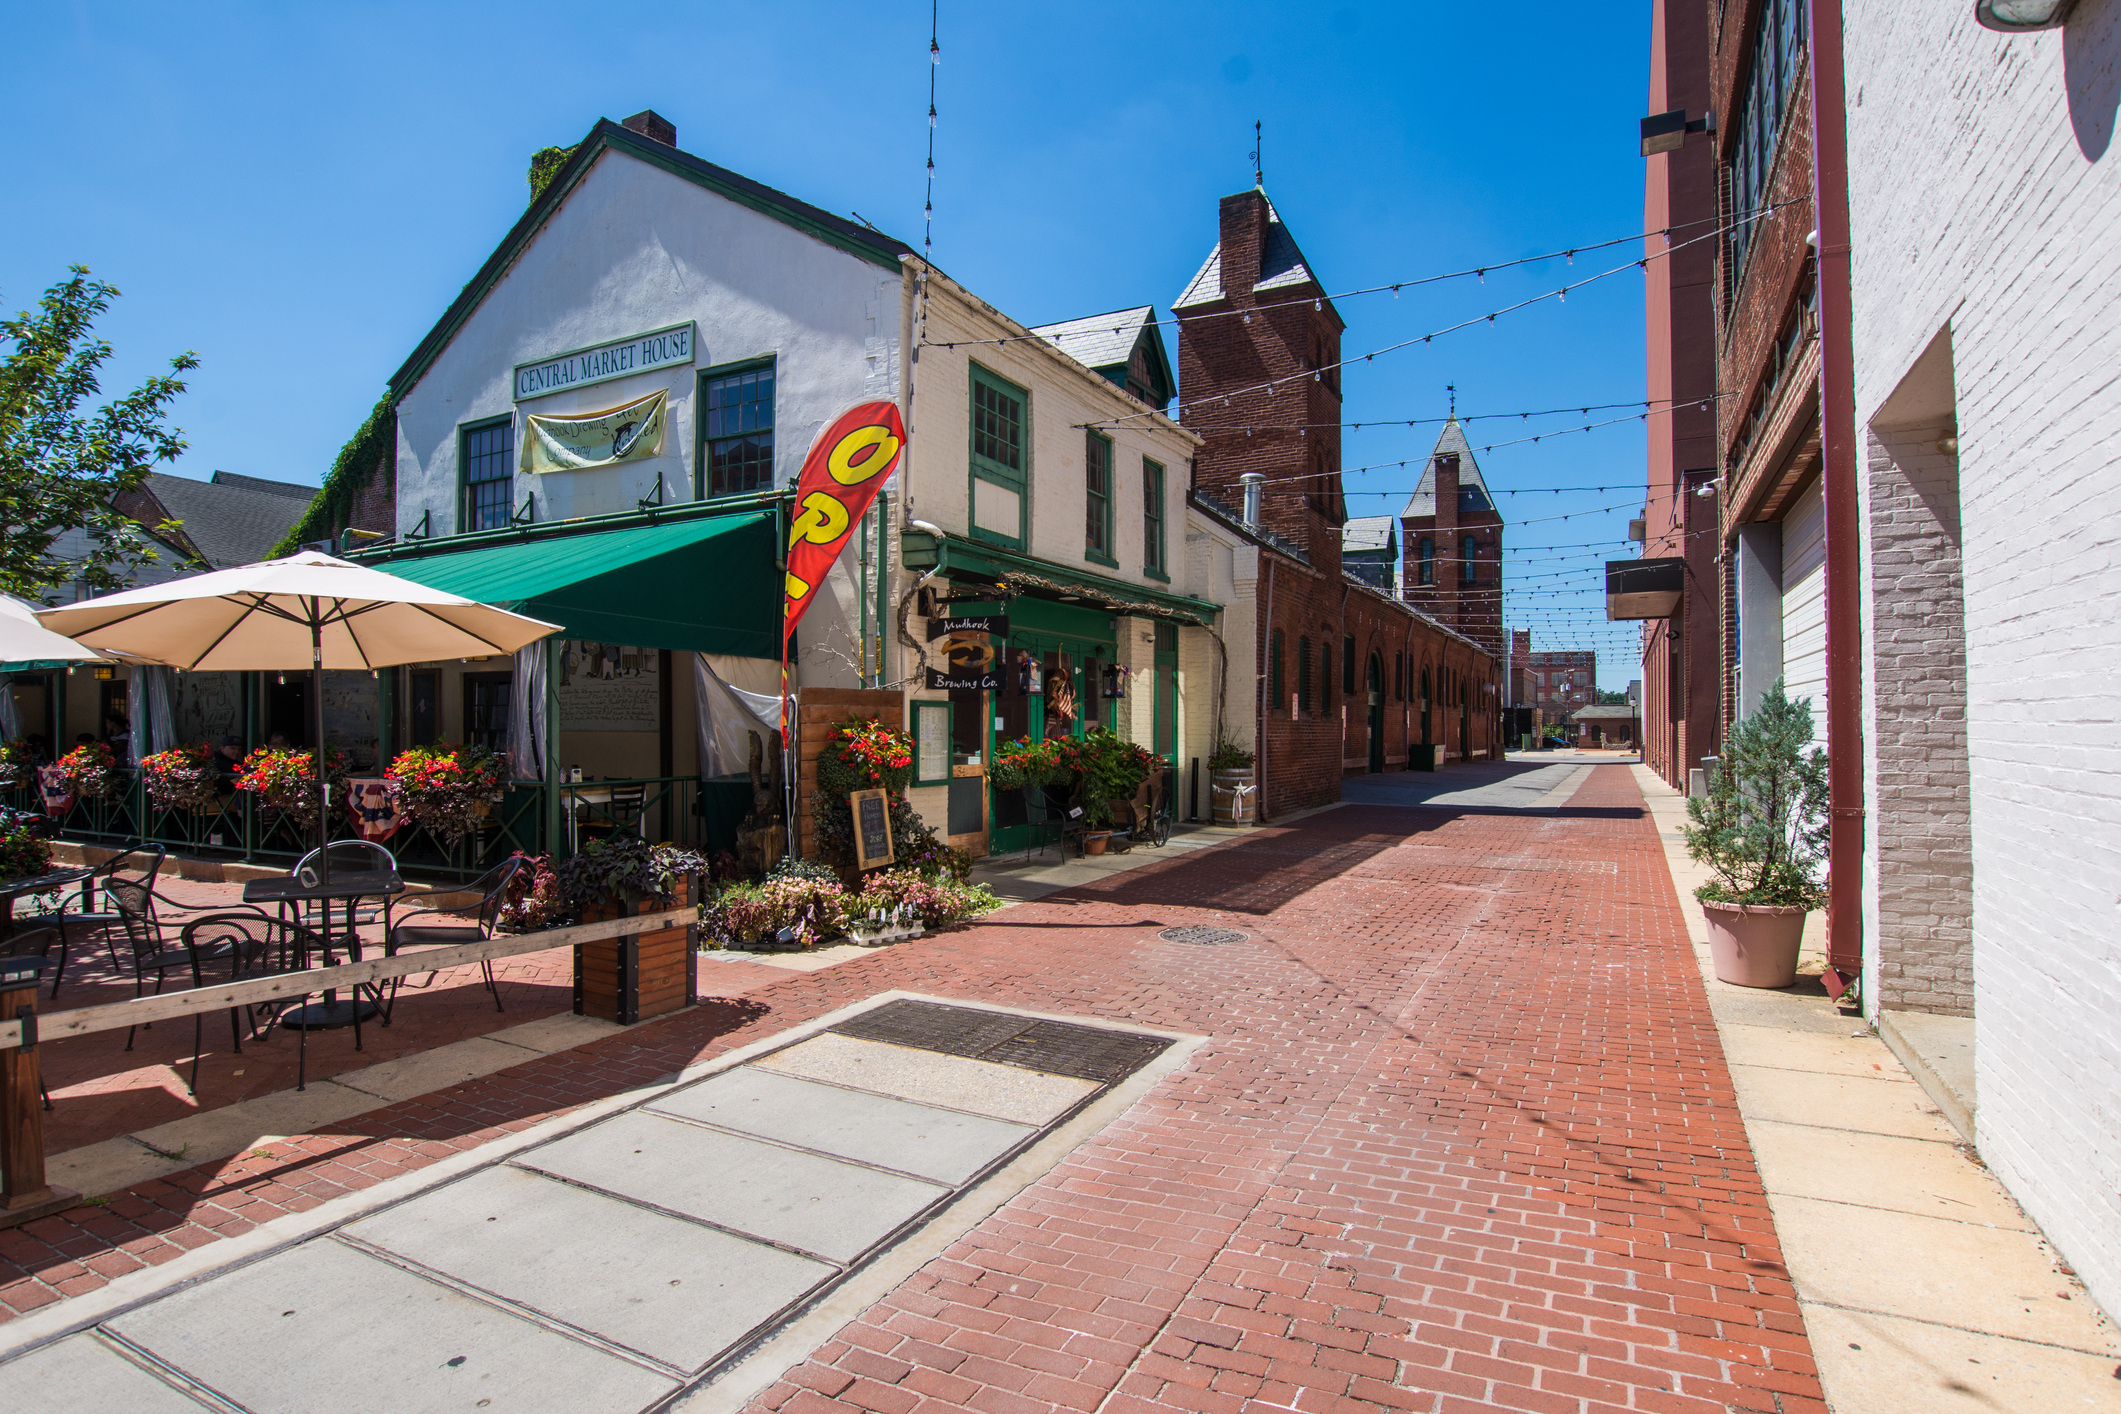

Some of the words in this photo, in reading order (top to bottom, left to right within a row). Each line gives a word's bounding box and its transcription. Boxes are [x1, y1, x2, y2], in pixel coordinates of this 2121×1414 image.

[521, 361, 577, 393] CENTRAL
[581, 345, 636, 379] MARKET
[642, 332, 688, 364] HOUSE
[943, 617, 990, 633] Mudhook
[934, 674, 977, 689] Brewing
[981, 675, 998, 688] Co.
[862, 800, 880, 811] FREE
